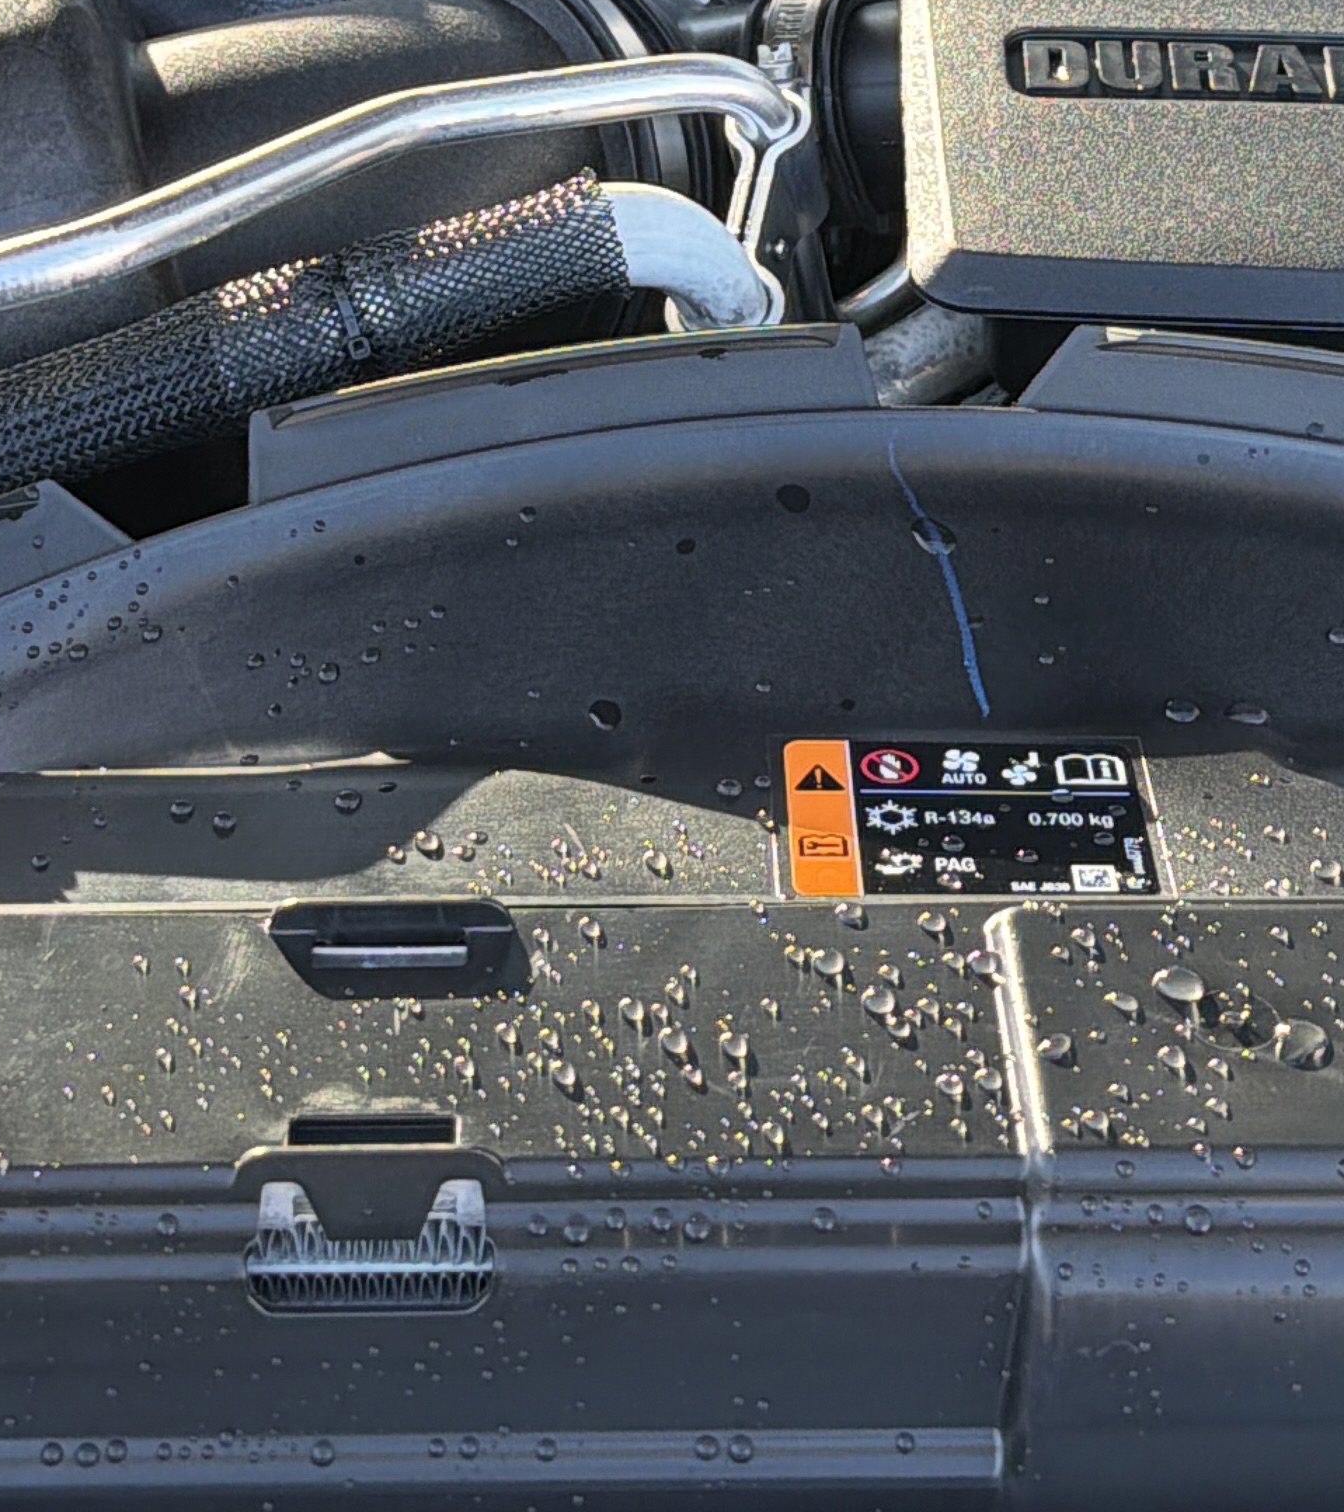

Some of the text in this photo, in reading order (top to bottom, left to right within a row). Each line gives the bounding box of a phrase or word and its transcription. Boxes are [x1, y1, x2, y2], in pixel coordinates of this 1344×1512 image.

[941, 772, 988, 785] AUTO
[924, 809, 996, 825] R-134a
[1027, 812, 1115, 829] 0.700 kg
[934, 856, 977, 872] PAG
